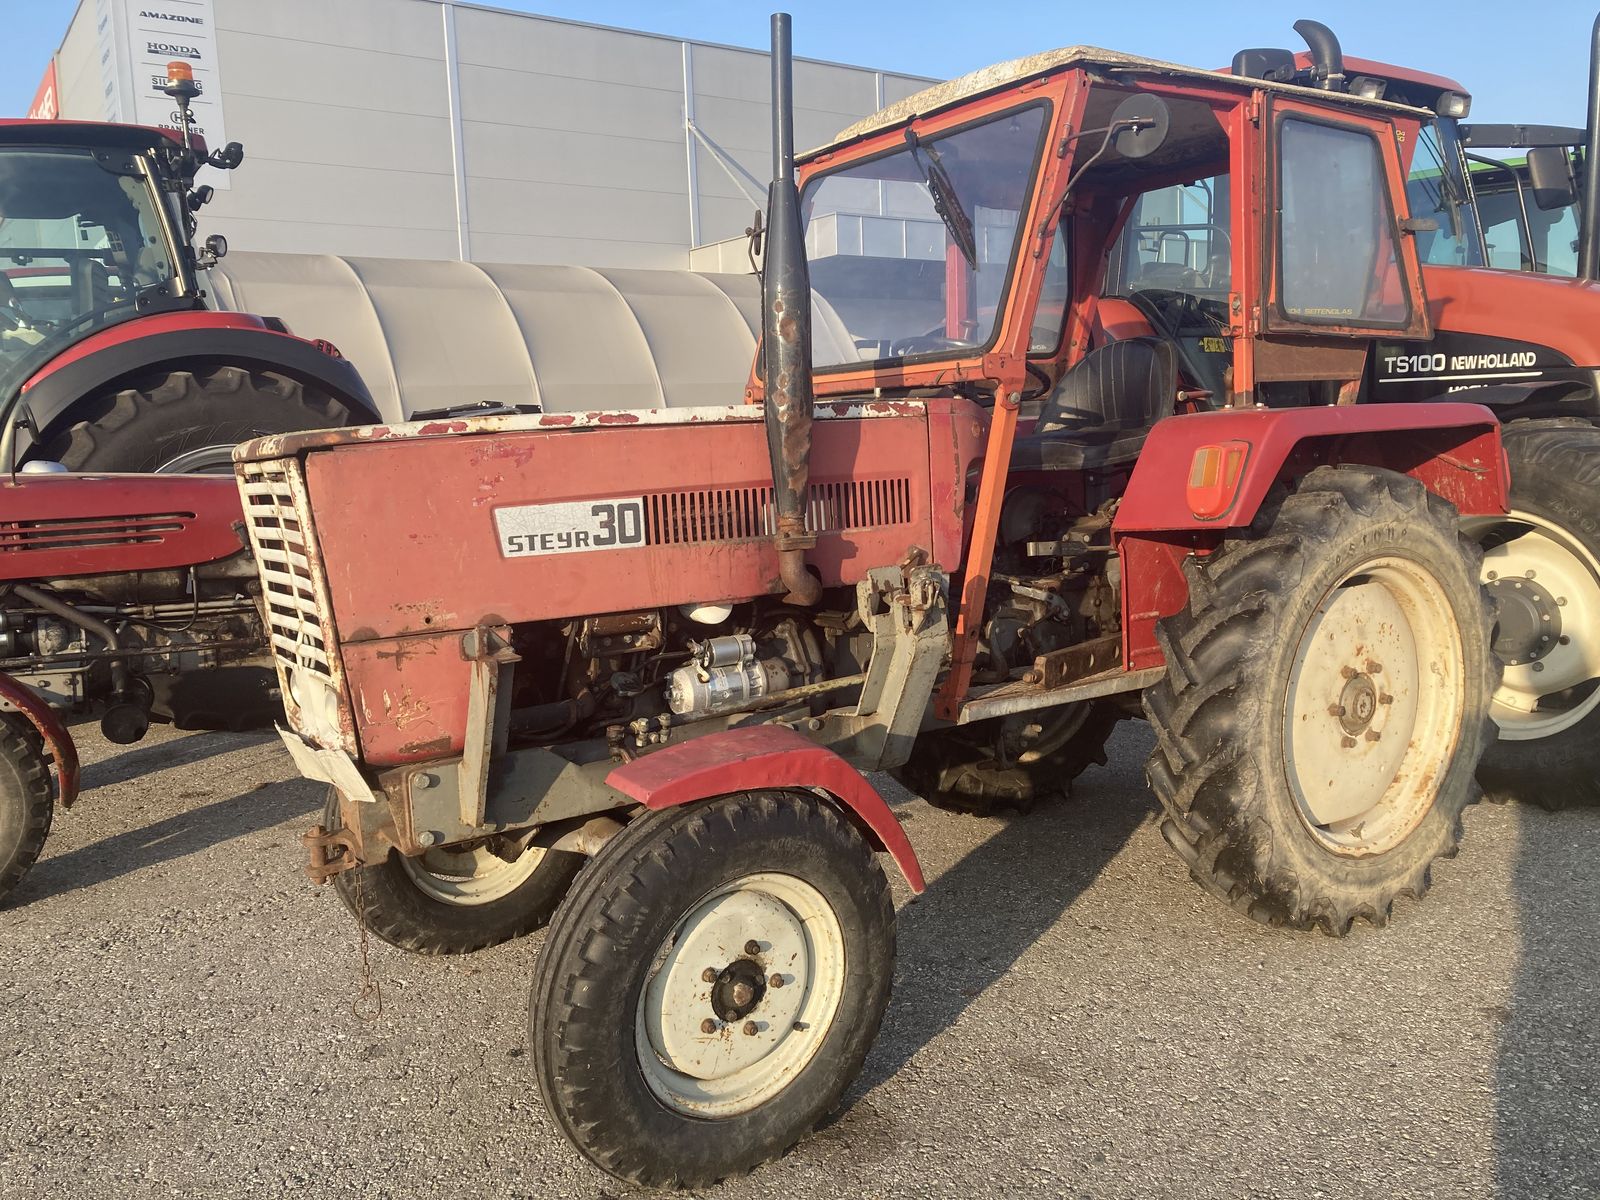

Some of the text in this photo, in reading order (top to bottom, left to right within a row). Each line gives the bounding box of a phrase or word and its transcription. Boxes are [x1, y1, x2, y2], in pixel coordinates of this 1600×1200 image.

[139, 10, 204, 25] AMAZONE
[147, 41, 201, 55] HONDA
[151, 77, 203, 90] SILG
[1384, 353, 1446, 374] TS100
[508, 502, 642, 553] STEYR 30
